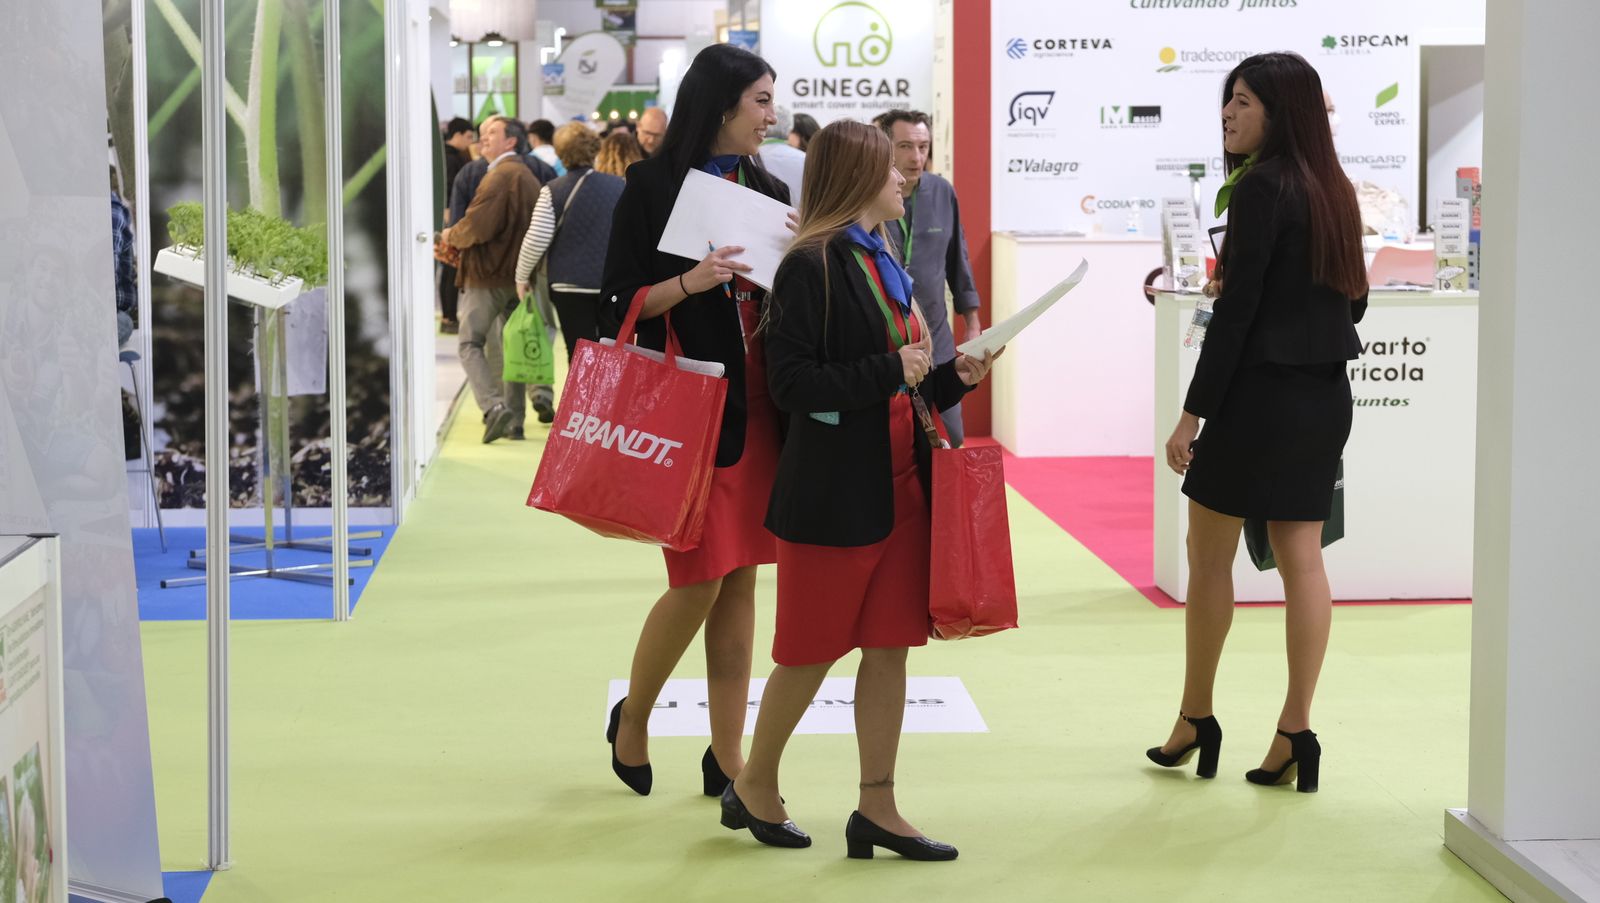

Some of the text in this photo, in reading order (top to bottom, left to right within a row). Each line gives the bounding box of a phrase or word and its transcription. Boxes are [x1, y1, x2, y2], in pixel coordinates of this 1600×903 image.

[1033, 39, 1112, 50] CORTEVA
[1340, 35, 1409, 47] SIPCAM
[793, 79, 910, 97] GINEGAR
[793, 101, 910, 109] smart cover solutions
[1024, 159, 1080, 175] Valagro
[1097, 200, 1155, 209] CODIARO
